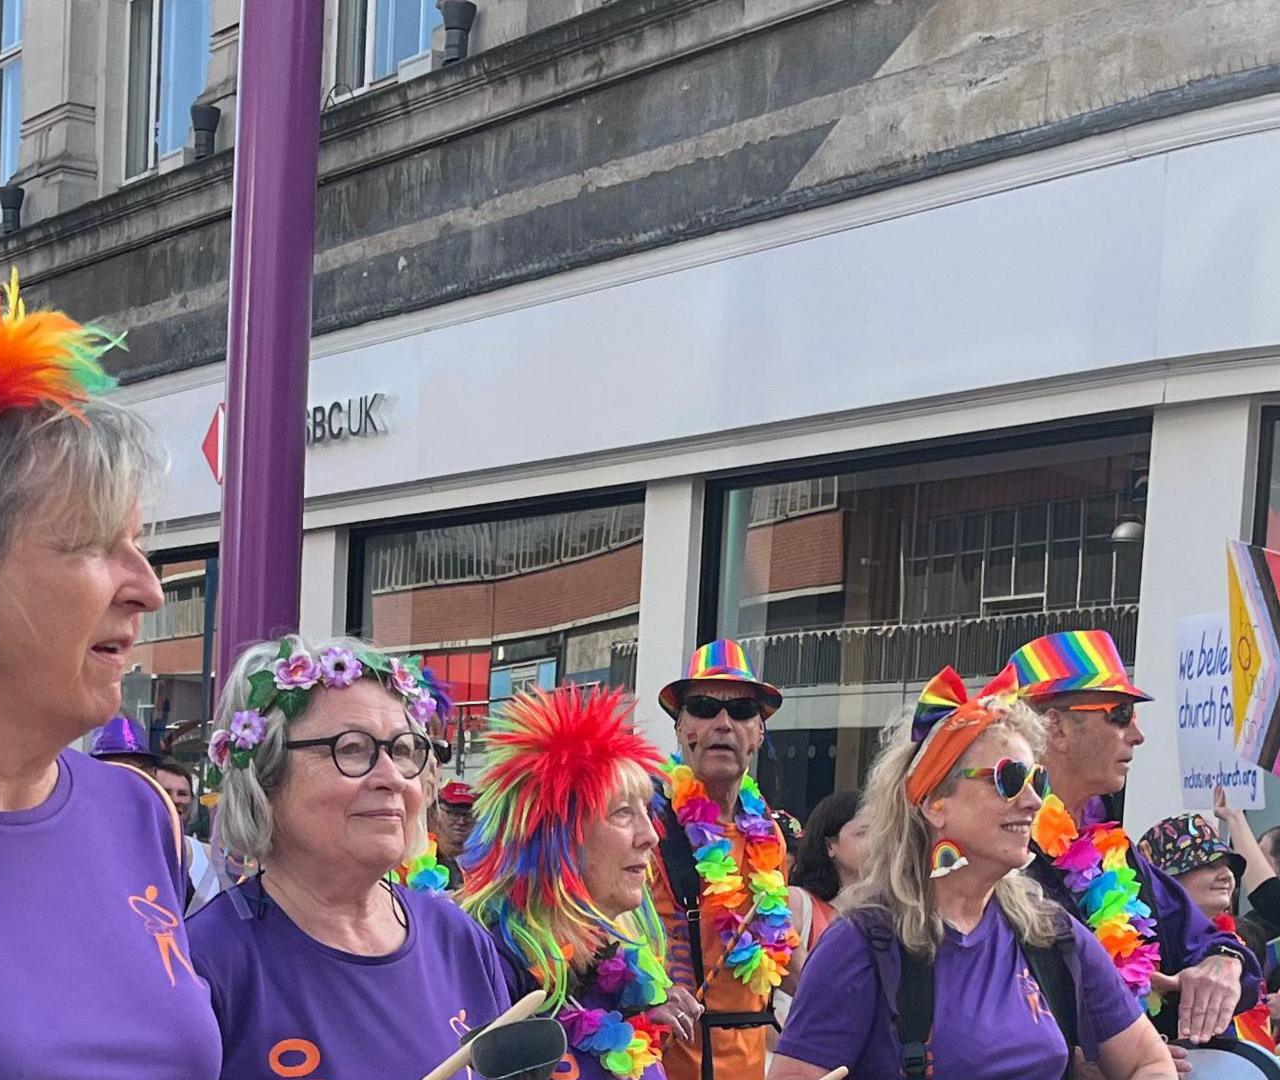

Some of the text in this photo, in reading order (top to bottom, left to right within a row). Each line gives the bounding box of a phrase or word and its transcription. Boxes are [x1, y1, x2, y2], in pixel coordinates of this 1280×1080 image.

[1197, 627, 1232, 680] belie
[1178, 685, 1234, 741] church fo
